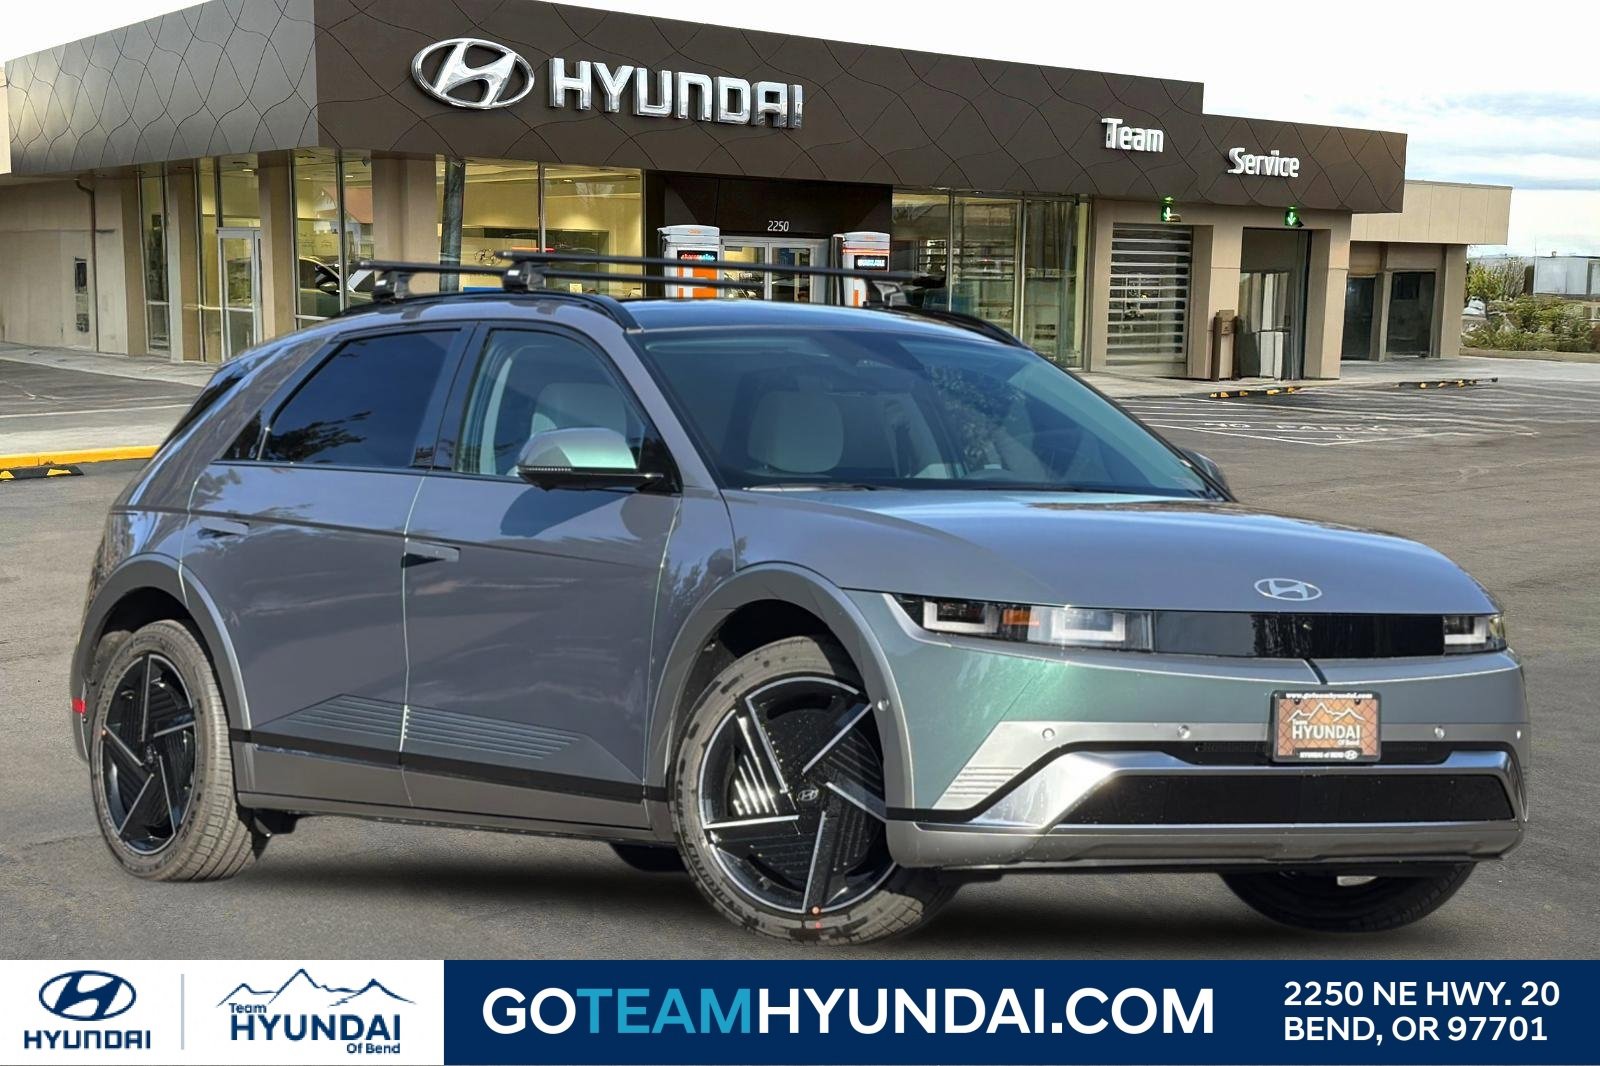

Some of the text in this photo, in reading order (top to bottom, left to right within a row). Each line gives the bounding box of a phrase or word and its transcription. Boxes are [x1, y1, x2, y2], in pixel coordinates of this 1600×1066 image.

[549, 57, 803, 129] HYUNDAI
[1101, 117, 1165, 153] Team
[1227, 147, 1300, 178] Service
[767, 220, 790, 232] 2250
[1292, 724, 1361, 740] HYUNDAI
